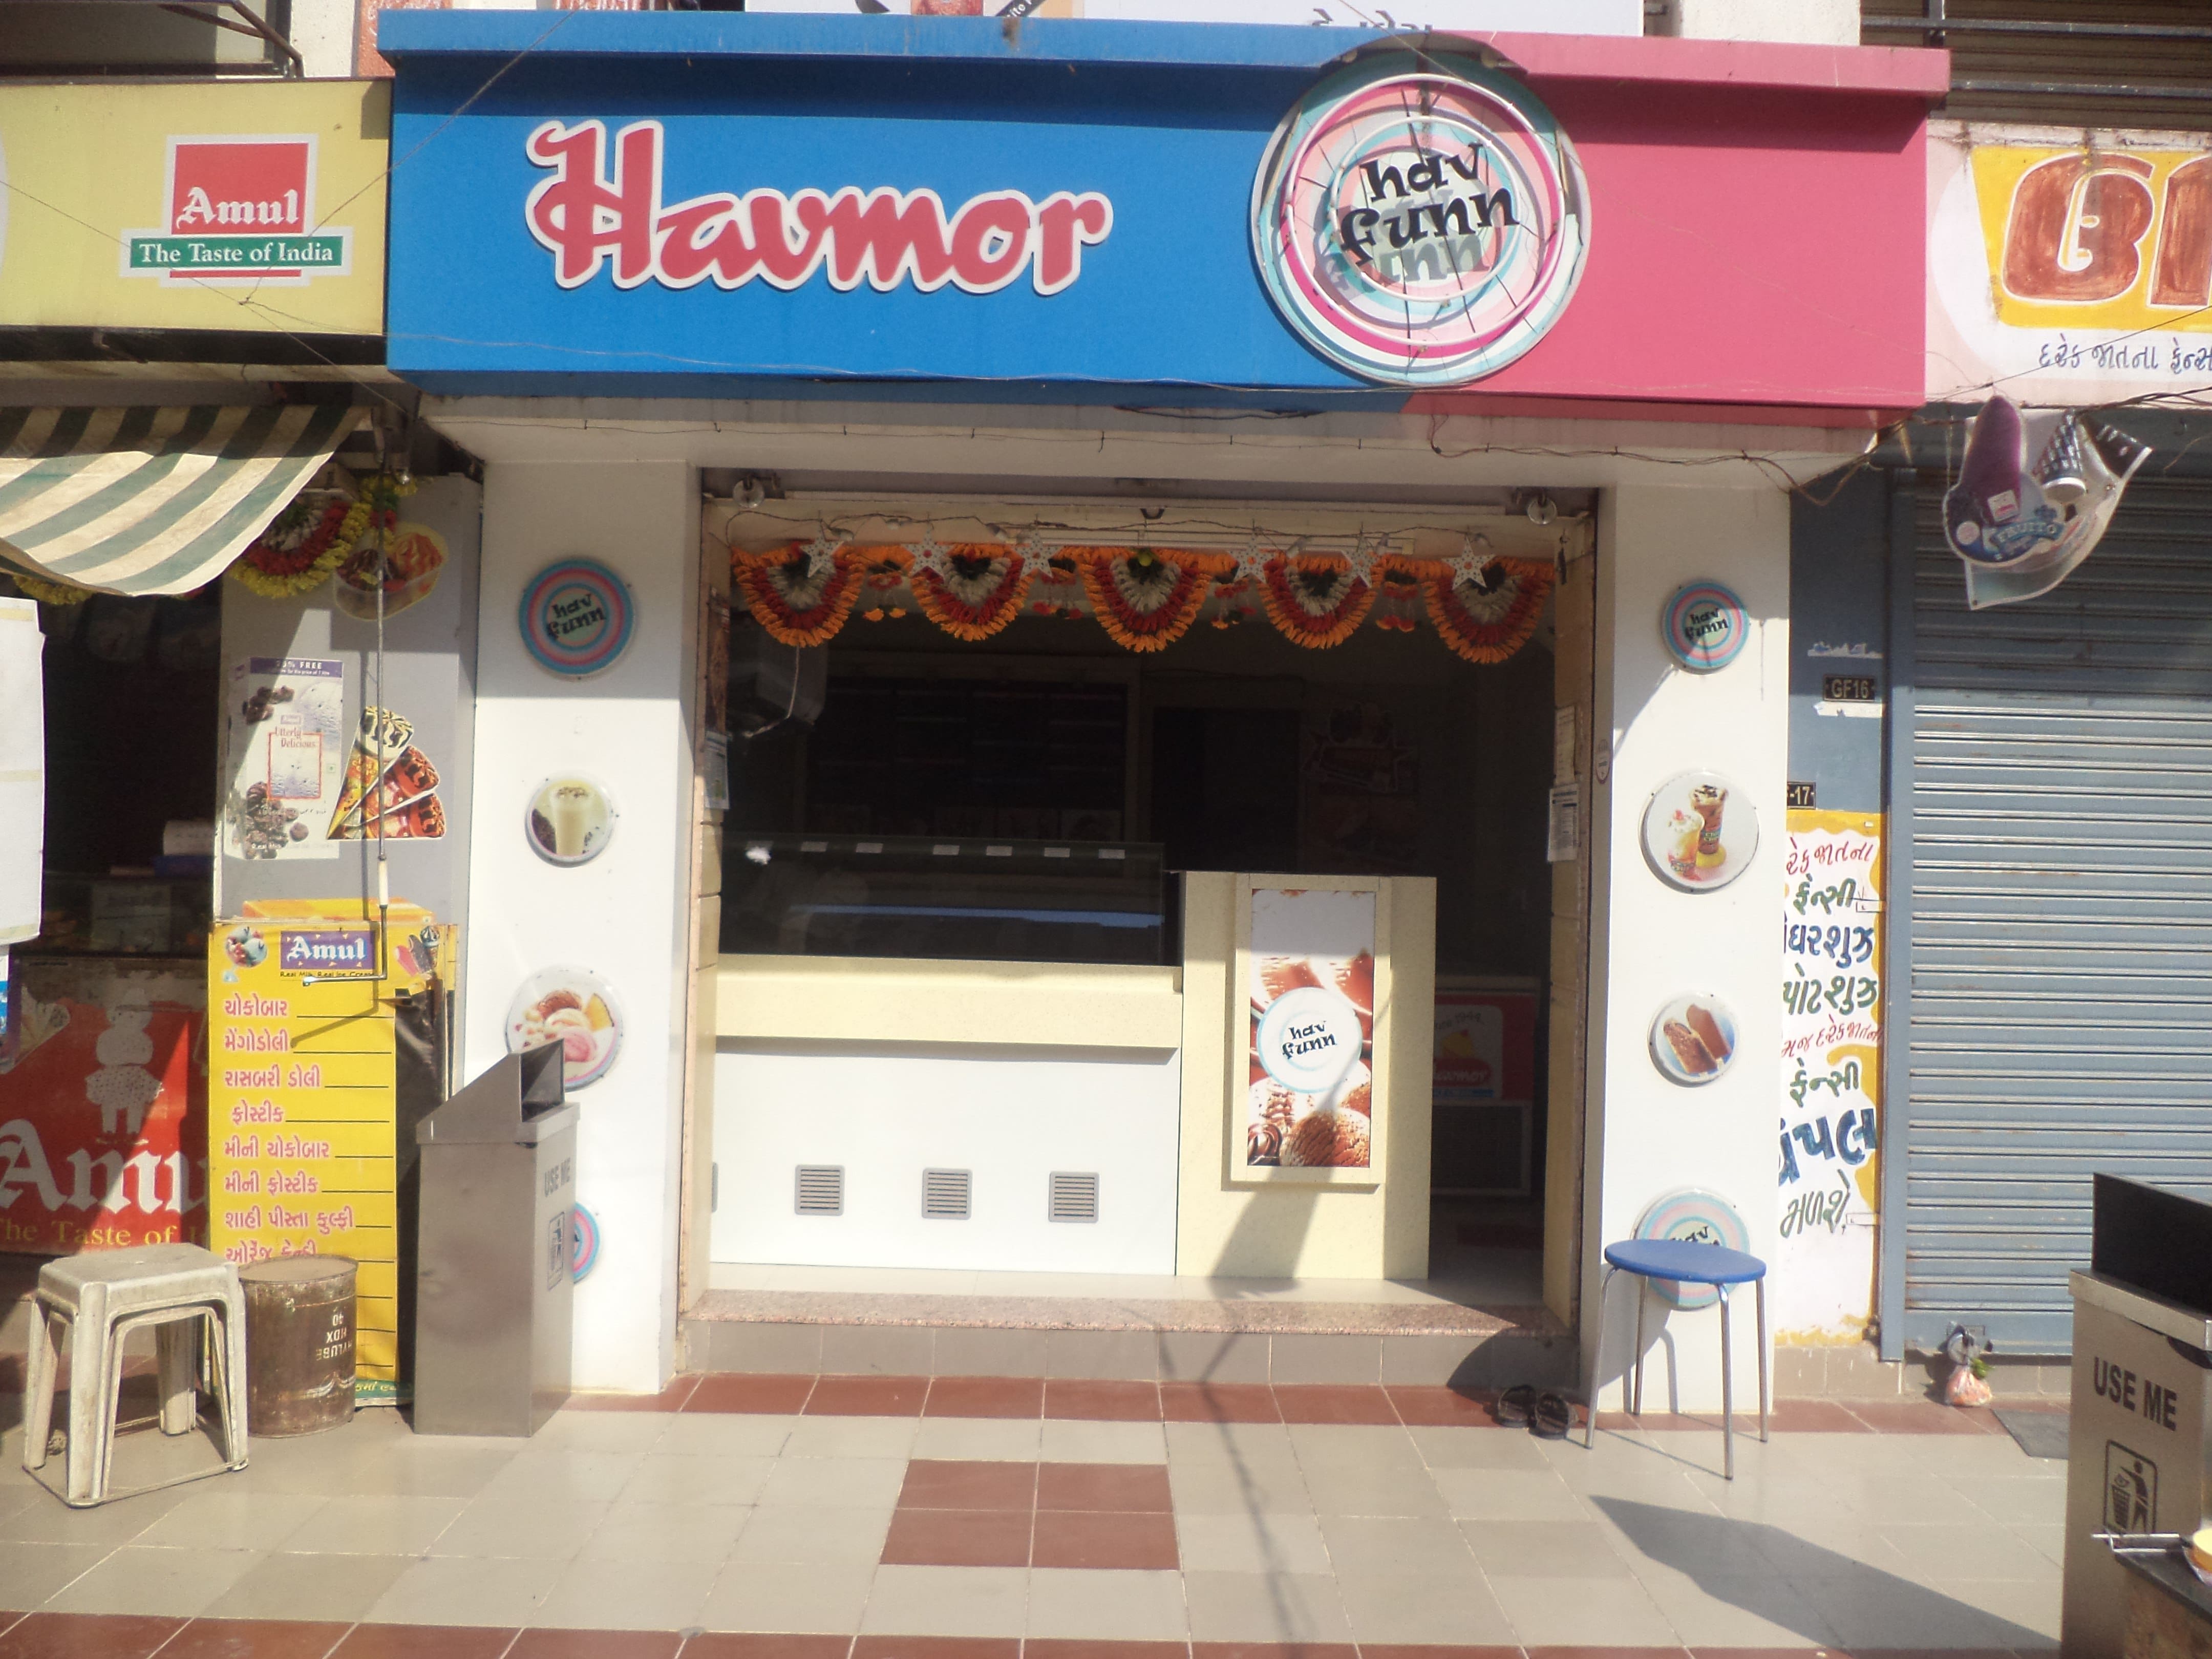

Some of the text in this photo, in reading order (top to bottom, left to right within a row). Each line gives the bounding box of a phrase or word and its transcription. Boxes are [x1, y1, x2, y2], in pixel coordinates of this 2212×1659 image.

[1360, 142, 1483, 202] hav
[176, 186, 299, 229] Amul
[527, 121, 1112, 294] Havmor
[1340, 187, 1520, 265] funn
[139, 242, 333, 263] The Taste of India
[2038, 332, 2080, 368] દરેક
[2092, 344, 2159, 369] જાતના
[552, 593, 591, 618] hav
[1691, 608, 1719, 624] hav
[547, 607, 606, 640] funn
[1685, 619, 1728, 640] funn
[1832, 679, 1869, 698] GF16
[275, 726, 301, 738] Utterly
[281, 738, 315, 748] Delicious
[1814, 841, 1873, 865] જાતના
[287, 935, 365, 961] Amul
[225, 993, 288, 1016] ચોકોબાર
[225, 1028, 288, 1051] મેંગોડોલી
[1289, 1021, 1326, 1040] hav
[1282, 1033, 1336, 1059] funn
[225, 1064, 320, 1087] રાસબરી ડોલી
[232, 1100, 284, 1125] ફોસ્ટીક
[224, 1136, 329, 1158] મીની ચોકોબાર
[224, 1170, 318, 1195] મીની ફોસ્ટીક
[545, 1157, 570, 1197] USE ME
[226, 1205, 353, 1235] શાહી પીસ્તા કુલ્ફી
[51, 1220, 131, 1246] Taste
[144, 1225, 177, 1245] of
[326, 1327, 347, 1344] HDX
[2094, 1357, 2178, 1431] USE ME
